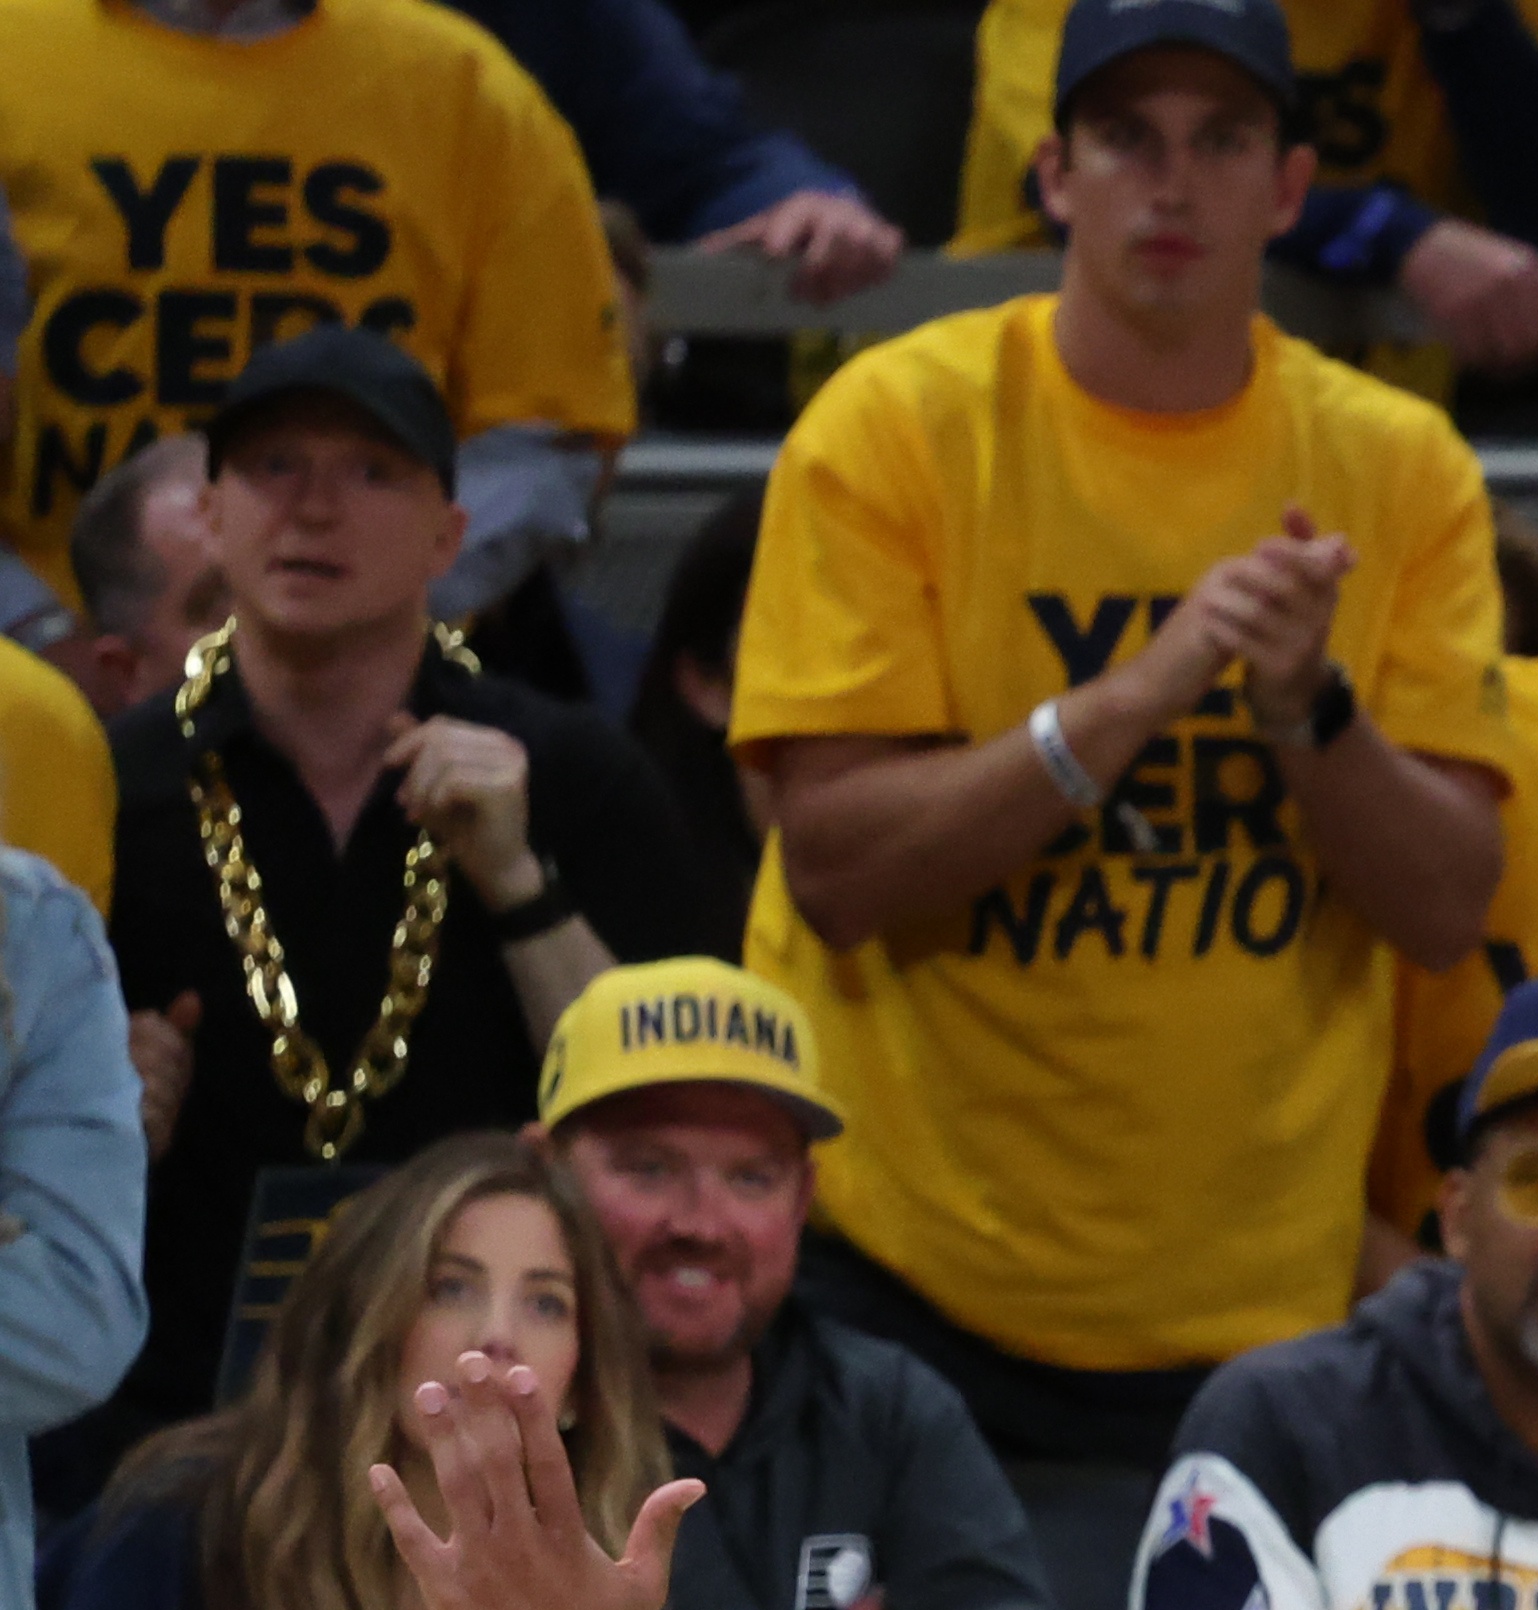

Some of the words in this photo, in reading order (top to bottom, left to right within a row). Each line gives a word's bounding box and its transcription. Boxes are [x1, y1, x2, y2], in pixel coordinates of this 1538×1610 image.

[91, 154, 392, 279] YES
[969, 857, 1326, 964] NATIO
[619, 991, 800, 1071] INDIANA
